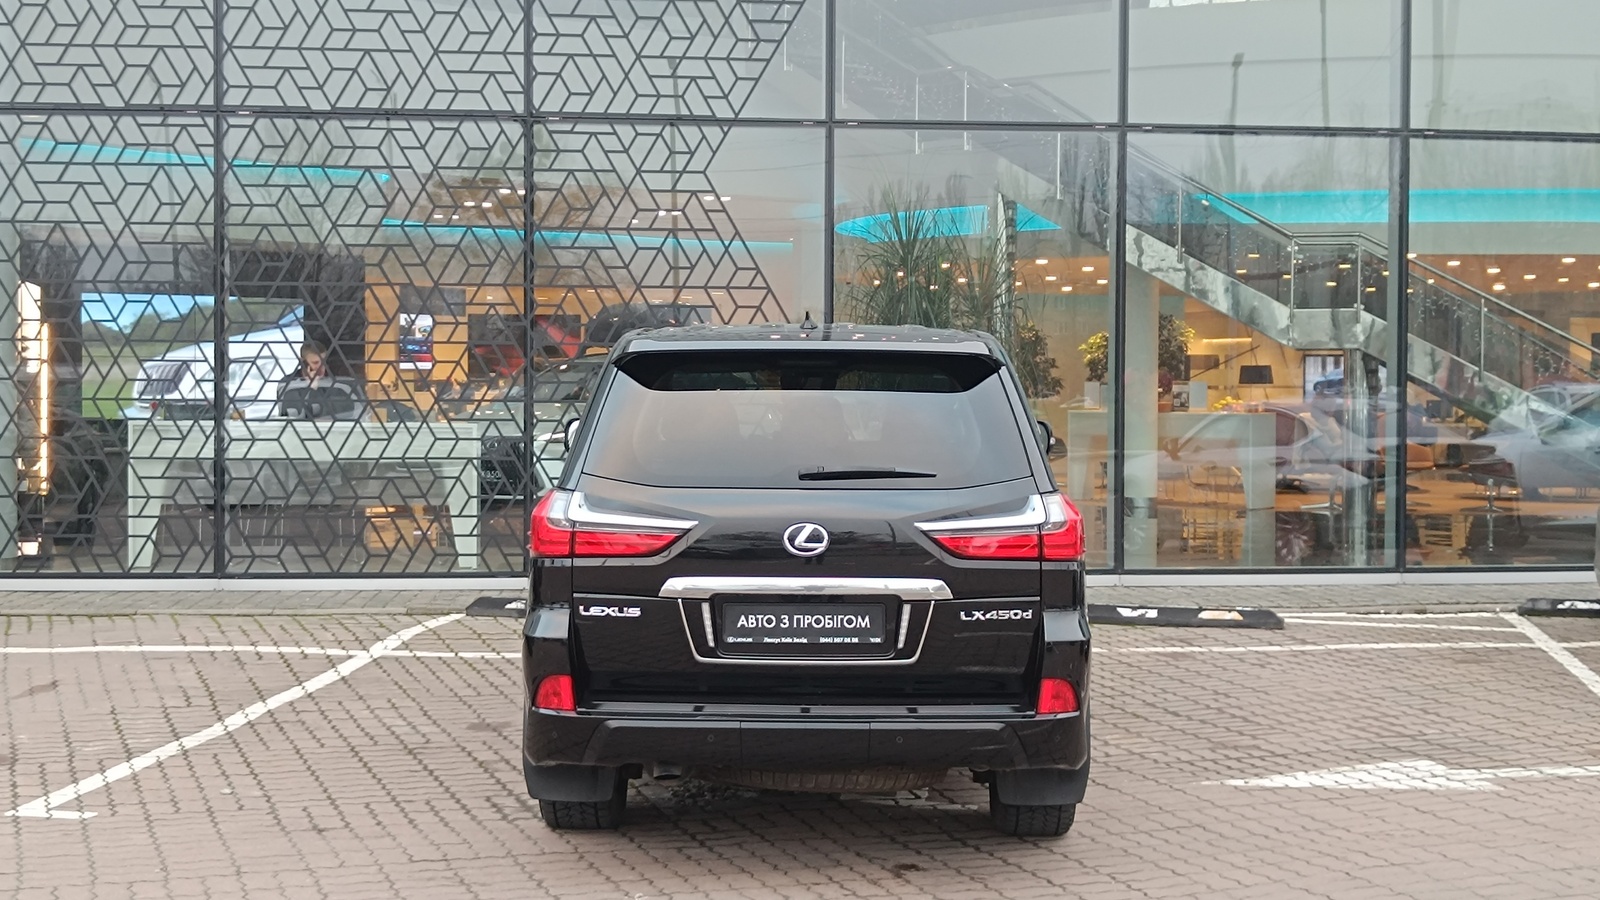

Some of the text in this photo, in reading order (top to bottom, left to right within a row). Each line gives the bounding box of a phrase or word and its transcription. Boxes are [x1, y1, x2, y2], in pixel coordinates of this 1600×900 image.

[579, 605, 641, 617] LEXUS
[960, 609, 1033, 620] LX450d
[737, 614, 776, 628] АВТО
[793, 614, 871, 628] ПРОБІГОМ
